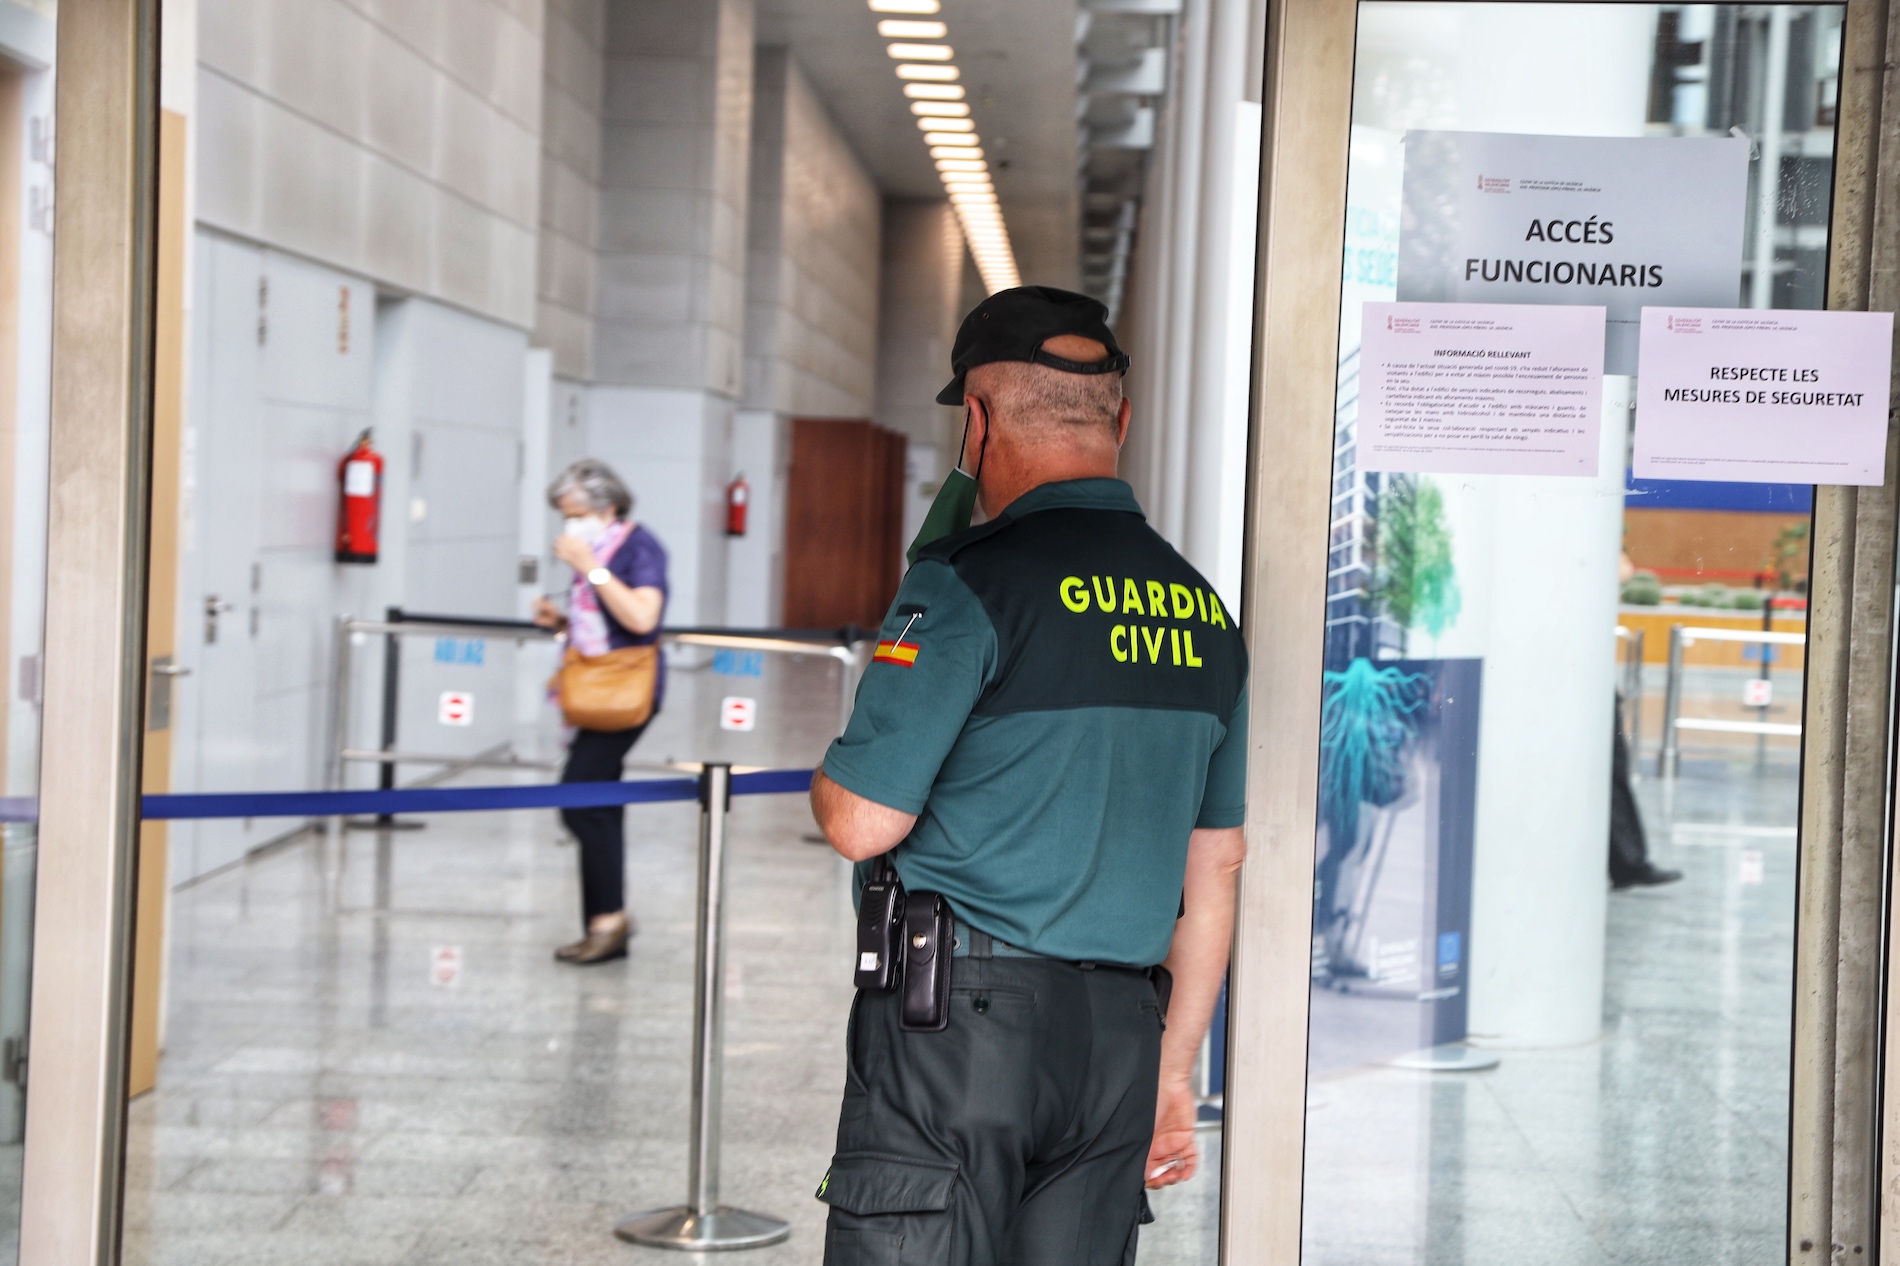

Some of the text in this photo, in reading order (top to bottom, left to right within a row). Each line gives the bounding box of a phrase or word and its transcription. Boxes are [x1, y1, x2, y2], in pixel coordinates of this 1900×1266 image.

[1525, 215, 1614, 245] ACCÉS
[1465, 259, 1663, 288] FUNCIONARIS
[1434, 349, 1486, 358] INFORMACIÓ
[1710, 367, 1819, 383] RESPECTE LES
[1664, 388, 1865, 408] MESURES DE SEGURETAT
[1060, 576, 1227, 630] GUARDIA
[1110, 625, 1203, 668] CIVIL
